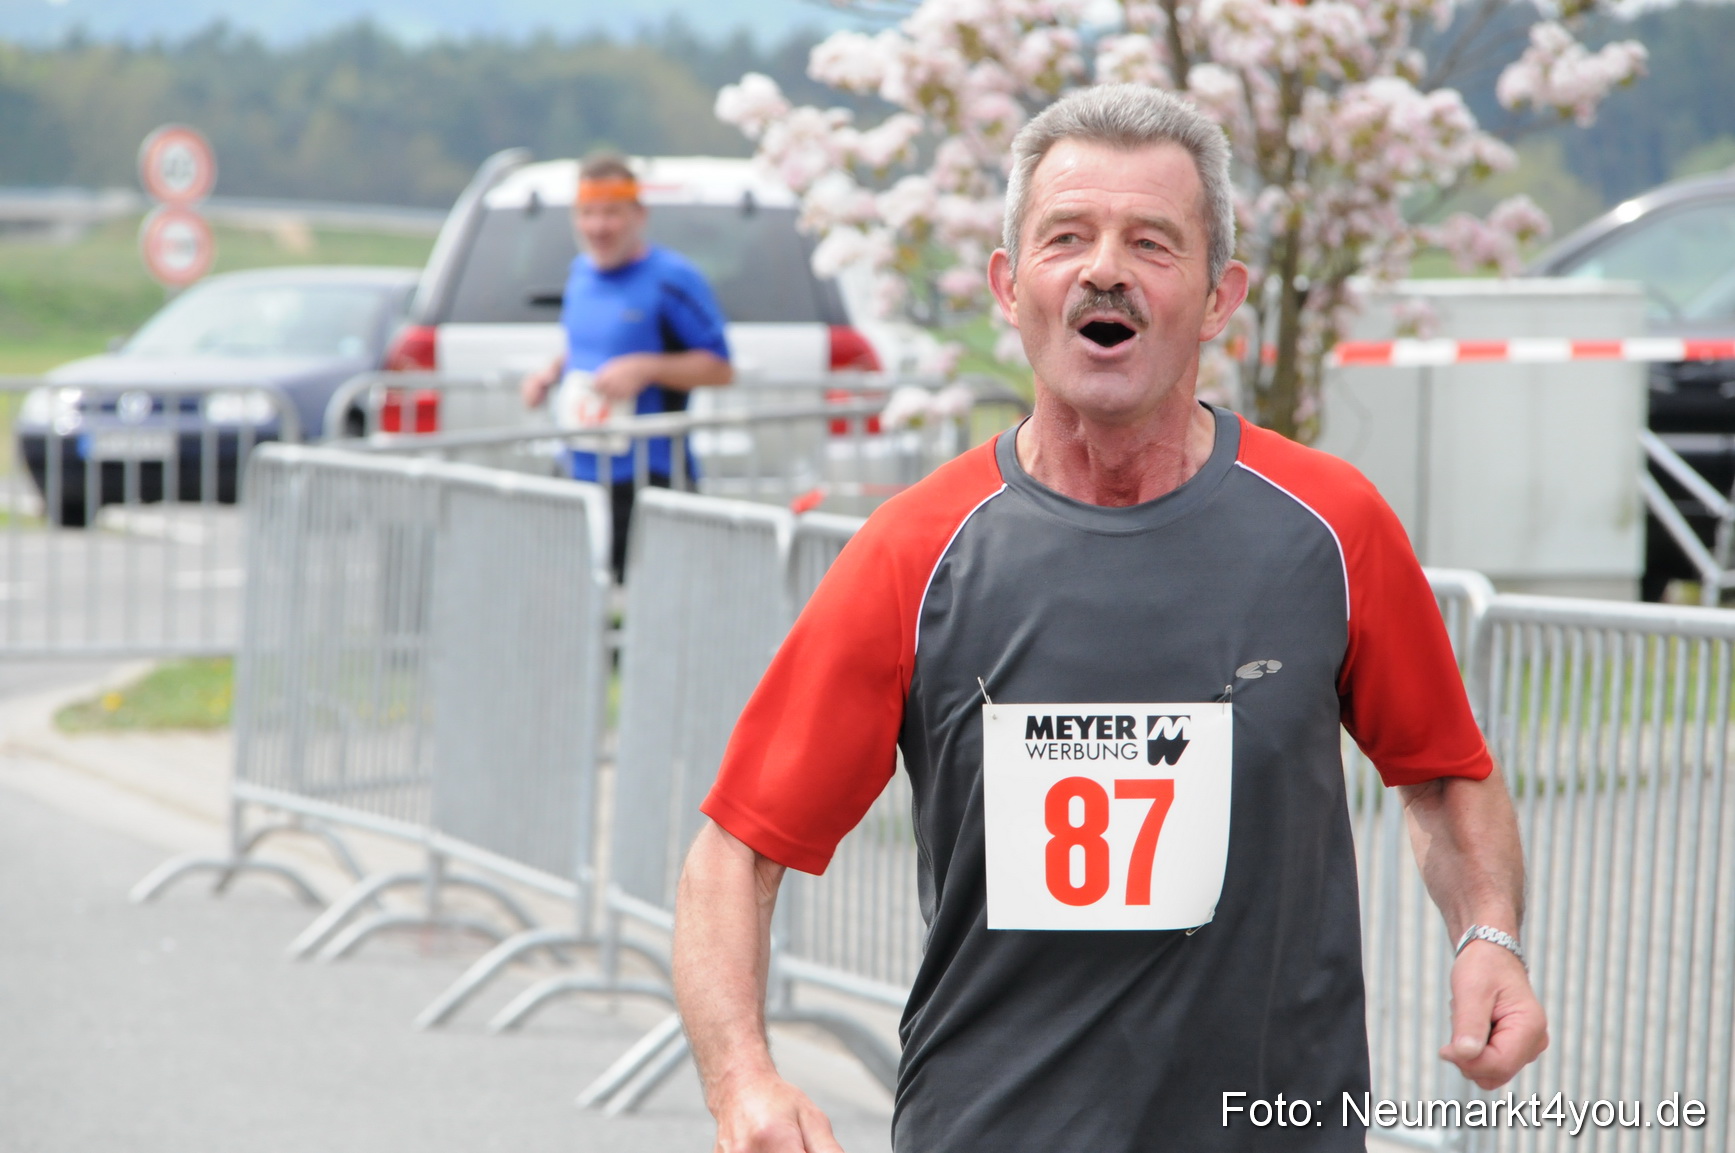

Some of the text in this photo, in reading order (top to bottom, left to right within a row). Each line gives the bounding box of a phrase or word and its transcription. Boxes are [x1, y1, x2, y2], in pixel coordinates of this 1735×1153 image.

[1025, 715, 1137, 740] MEYER
[1025, 742, 1138, 760] WERBUNG
[1044, 776, 1174, 906] 87
